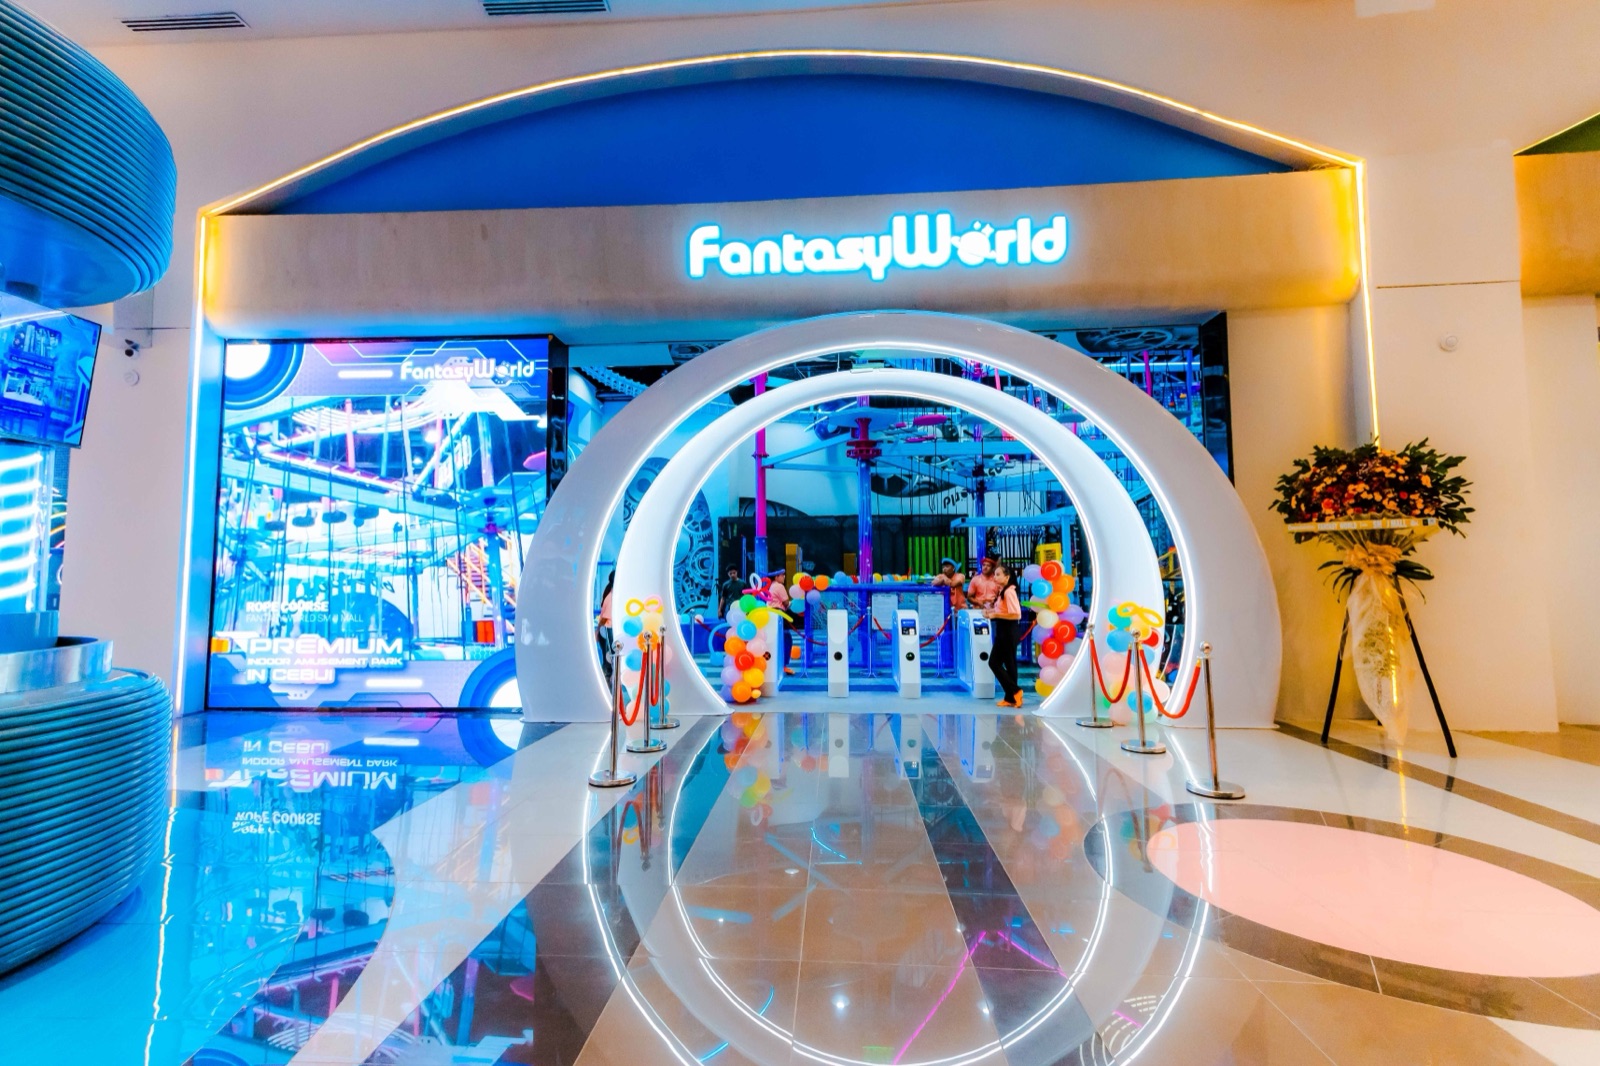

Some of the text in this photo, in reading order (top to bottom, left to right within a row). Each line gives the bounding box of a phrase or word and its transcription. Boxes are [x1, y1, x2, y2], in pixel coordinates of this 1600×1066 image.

[688, 212, 1067, 281] FantasyWorld
[400, 358, 535, 382] FantasyWorld
[246, 601, 279, 612] ROPE
[286, 613, 316, 623] WRLD
[249, 637, 403, 655] PREMIUM
[247, 657, 403, 666] INDOOR AMUSEMENT PARK
[247, 668, 266, 681] IN
